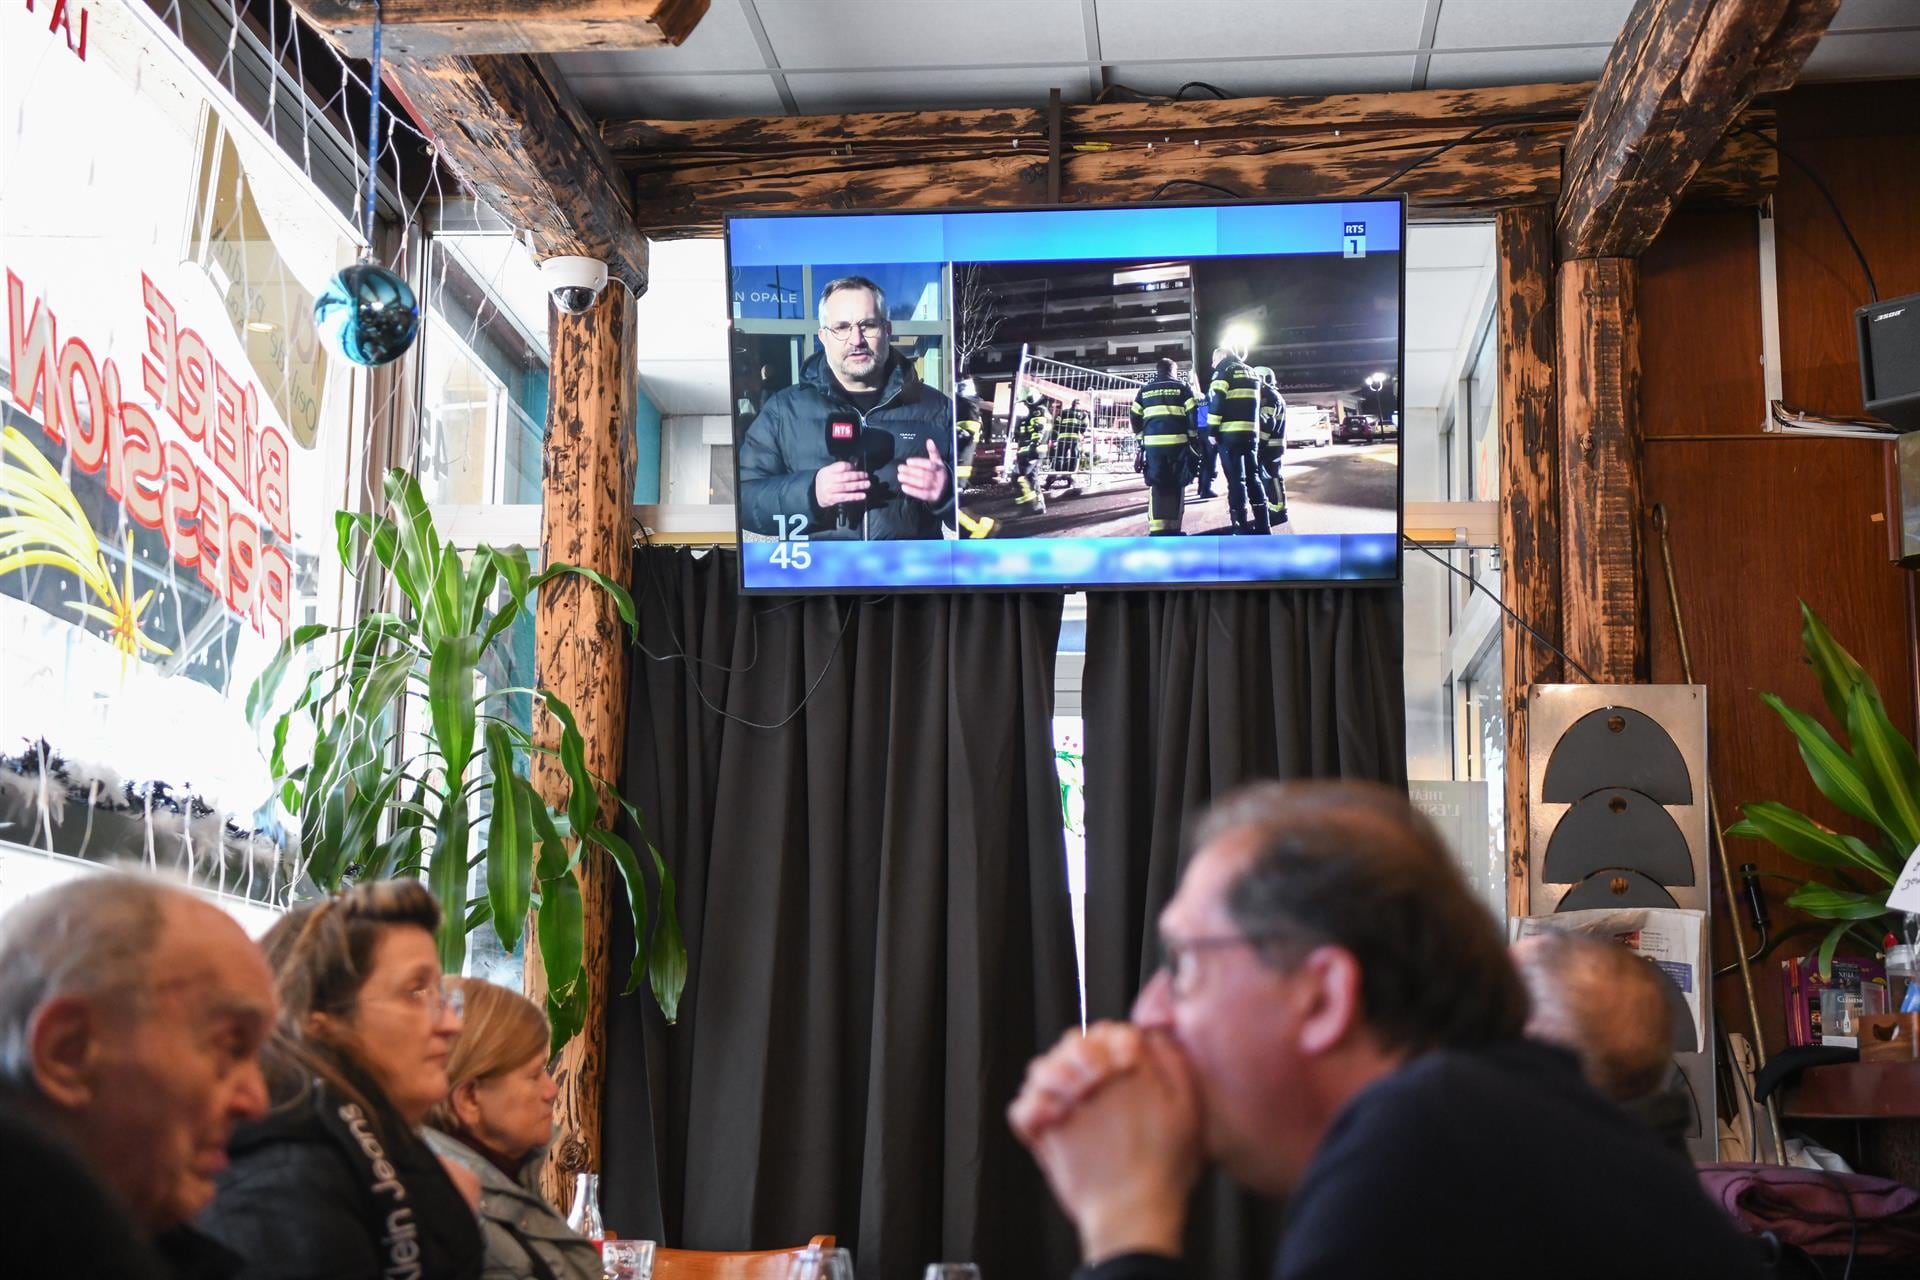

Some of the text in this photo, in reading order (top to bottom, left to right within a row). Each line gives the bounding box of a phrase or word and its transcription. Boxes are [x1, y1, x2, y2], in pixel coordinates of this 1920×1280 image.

[1345, 224, 1364, 234] RTS
[1350, 239, 1358, 255] 1
[750, 292, 798, 304] OPALE
[834, 425, 851, 435] RTS
[772, 514, 809, 541] 12
[769, 543, 811, 569] 45
